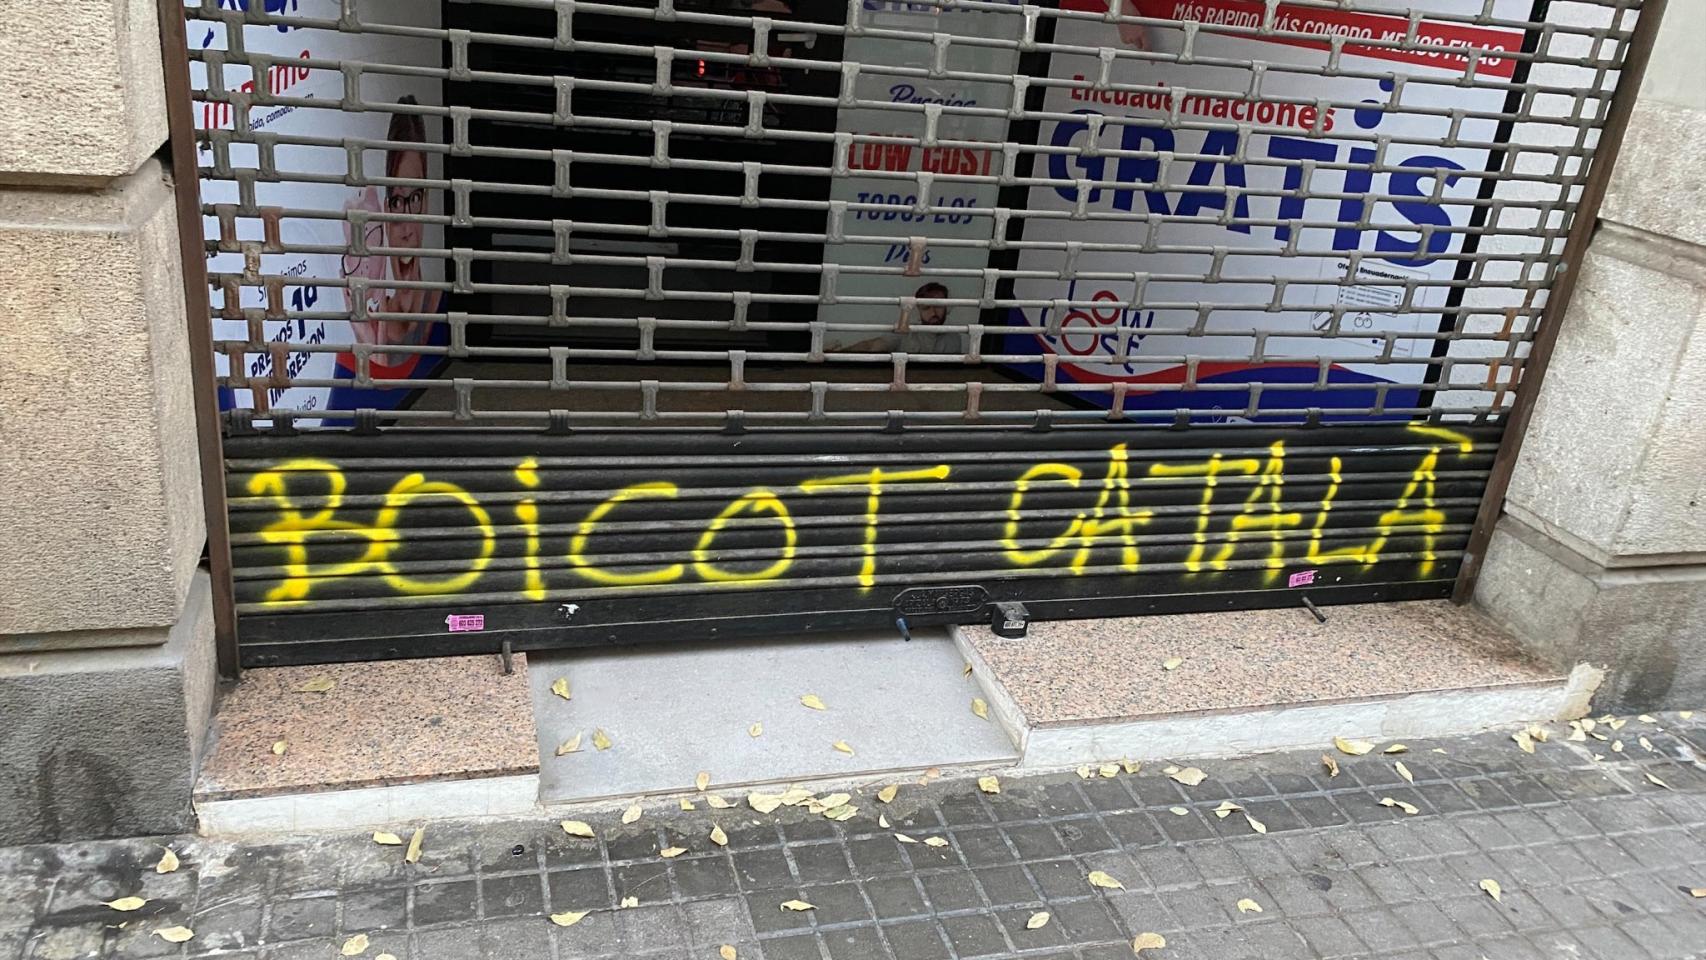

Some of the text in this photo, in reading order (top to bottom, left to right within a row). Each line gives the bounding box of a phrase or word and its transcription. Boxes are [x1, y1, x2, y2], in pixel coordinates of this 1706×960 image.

[1070, 74, 1337, 132] Encuadernaciones
[847, 132, 993, 178] LOW COST
